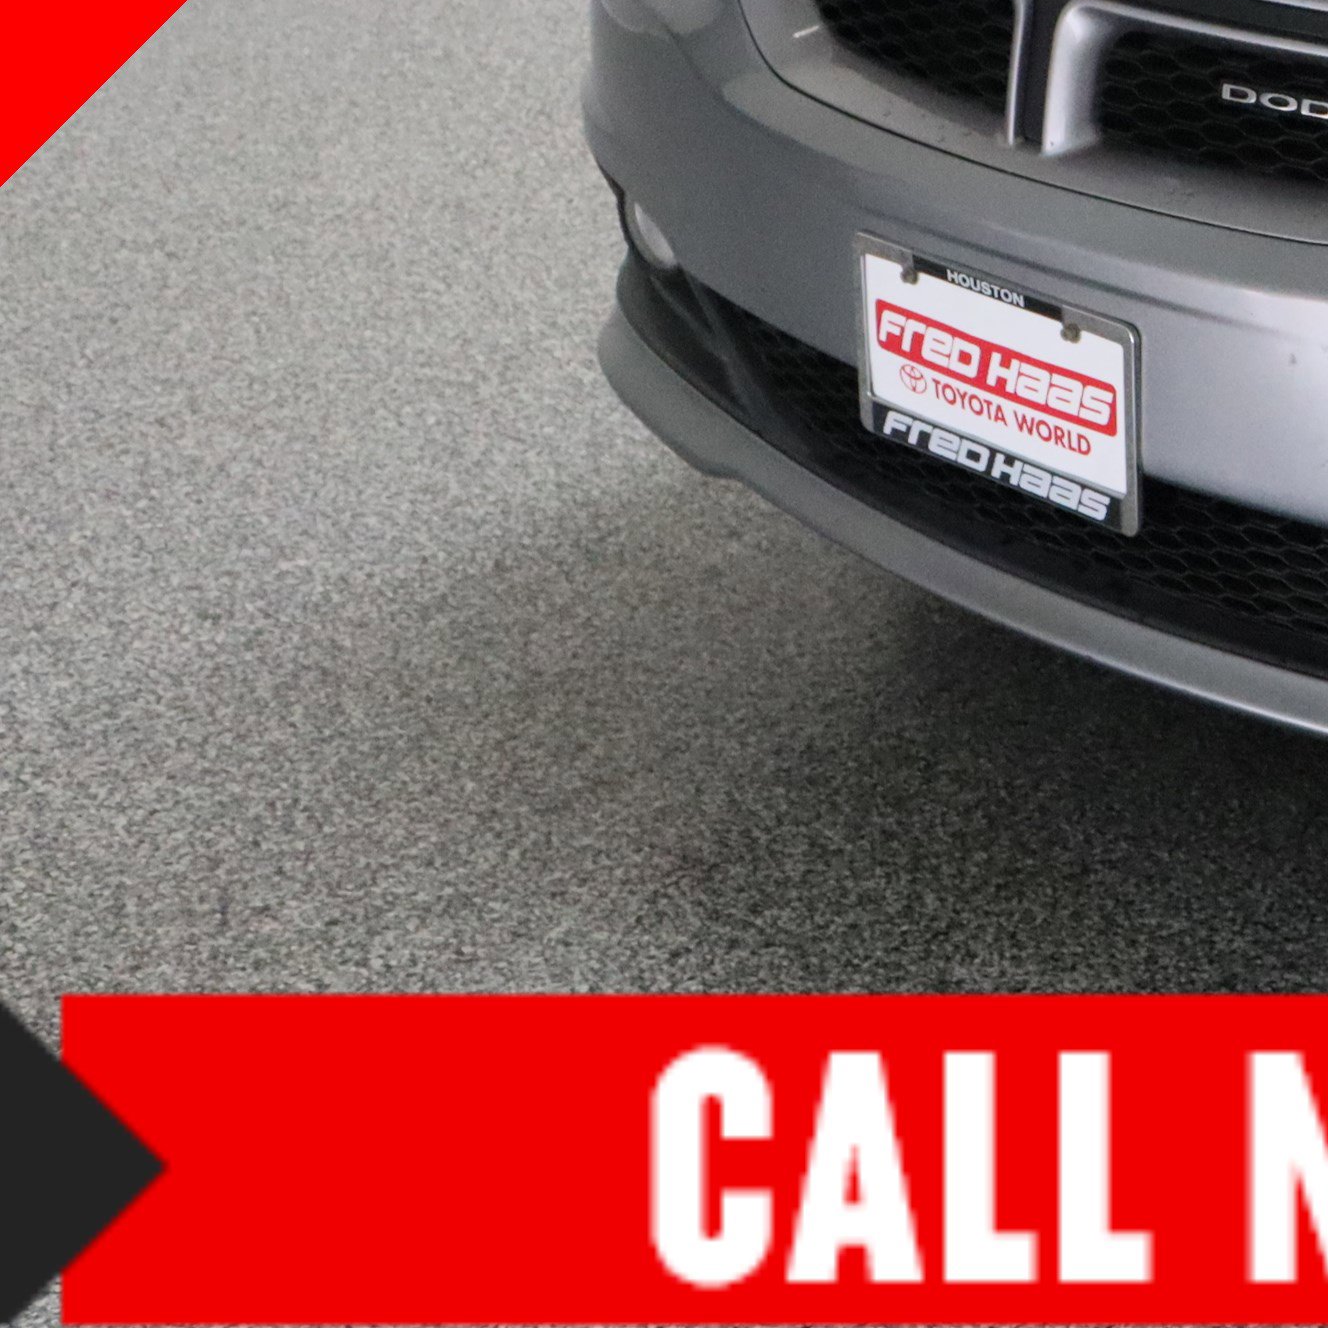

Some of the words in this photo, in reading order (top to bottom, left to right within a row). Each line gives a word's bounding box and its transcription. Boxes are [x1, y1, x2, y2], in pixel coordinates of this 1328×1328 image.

[946, 269, 1025, 307] HOUSTON
[932, 378, 1008, 426] TOYOTA
[1012, 409, 1091, 457] WORLD
